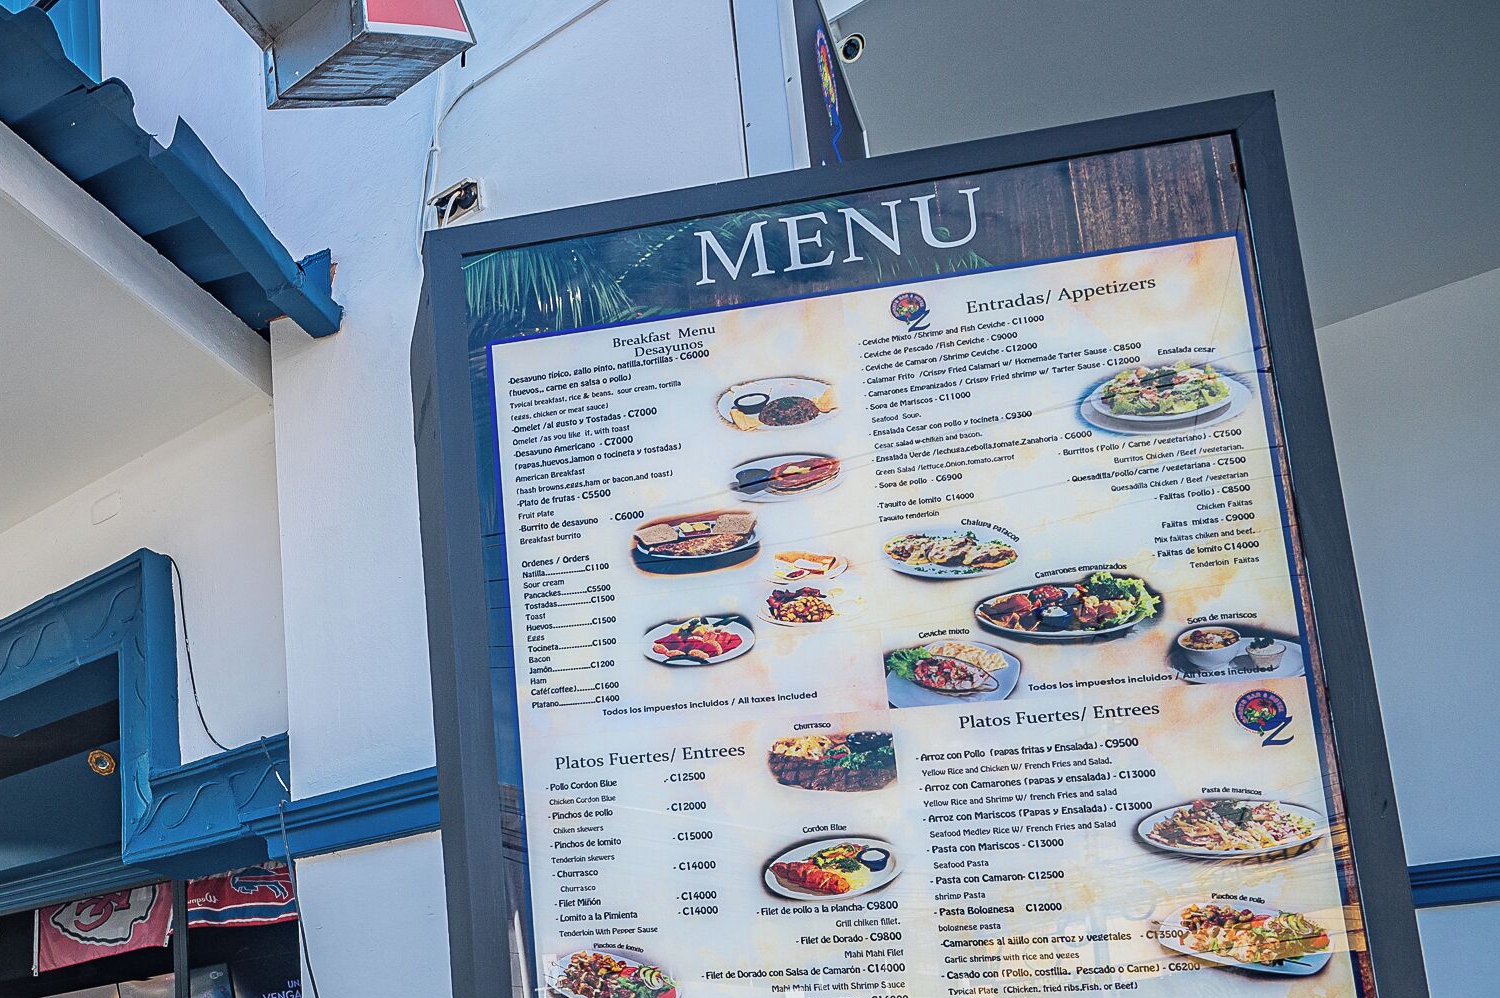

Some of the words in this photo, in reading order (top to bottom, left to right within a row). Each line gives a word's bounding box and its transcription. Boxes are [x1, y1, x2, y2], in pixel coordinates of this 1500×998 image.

[694, 187, 980, 286] MENU
[1057, 278, 1156, 303] Appetizers
[612, 331, 671, 348] Breakfast
[678, 326, 716, 339] Menu
[634, 340, 704, 357] Desayunos
[1157, 346, 1192, 356] Ensalada
[871, 414, 899, 424] Seafood
[554, 442, 596, 453] Americano
[604, 435, 634, 447] C7000
[515, 473, 549, 483] American
[550, 468, 585, 479] Breakfast
[540, 497, 551, 505] de
[551, 495, 576, 504] frutas
[581, 488, 611, 500] C5500
[1196, 502, 1226, 511] Chicken
[1191, 517, 1219, 526] mixtas
[1225, 512, 1255, 522] C9000
[519, 535, 554, 545] Breakfast
[556, 532, 582, 541] burrito
[521, 558, 554, 568] Ordenes
[562, 554, 590, 564] Orders
[1189, 559, 1230, 569] Tenderloin
[1034, 566, 1077, 579] Camarones
[1077, 562, 1127, 574] empanizados
[523, 581, 541, 589] Sour
[542, 579, 565, 587] cream
[525, 612, 546, 621] Toast
[1186, 616, 1208, 625] Sopa
[1208, 613, 1219, 621] de
[1220, 612, 1258, 620] mariscos
[918, 629, 947, 639] Ceviche
[528, 656, 551, 664] Bacon
[530, 677, 547, 685] Ham
[958, 714, 1011, 729] Platos
[1092, 705, 1160, 719] Entrees
[793, 722, 832, 731] Churrasco
[555, 755, 604, 770] Platos
[682, 746, 746, 761] Entrees
[669, 771, 706, 782] C12500
[549, 782, 569, 792] Pollo
[570, 781, 599, 790] Cordon
[599, 779, 618, 788] Blue
[1231, 787, 1262, 796] mariscos
[670, 801, 707, 812] C12000
[552, 811, 582, 820] Pinchos
[583, 809, 594, 818] de
[594, 808, 614, 817] pollo
[802, 824, 829, 834] Cordon
[830, 823, 847, 831] Blue
[677, 830, 713, 841] C15000
[931, 845, 958, 854] Pasta
[959, 844, 976, 853] con
[978, 841, 1020, 852] Mariscos
[1027, 838, 1064, 849] C13000
[550, 855, 586, 864] Tenderloin
[933, 860, 965, 870] Seafood
[966, 860, 989, 868] Pasta
[939, 907, 965, 916] Pasta
[967, 905, 1015, 915] Bolognesa
[1025, 902, 1062, 913] C12000
[844, 950, 864, 959] Mahi
[865, 949, 885, 958] Mahi
[886, 948, 904, 957] Filet
